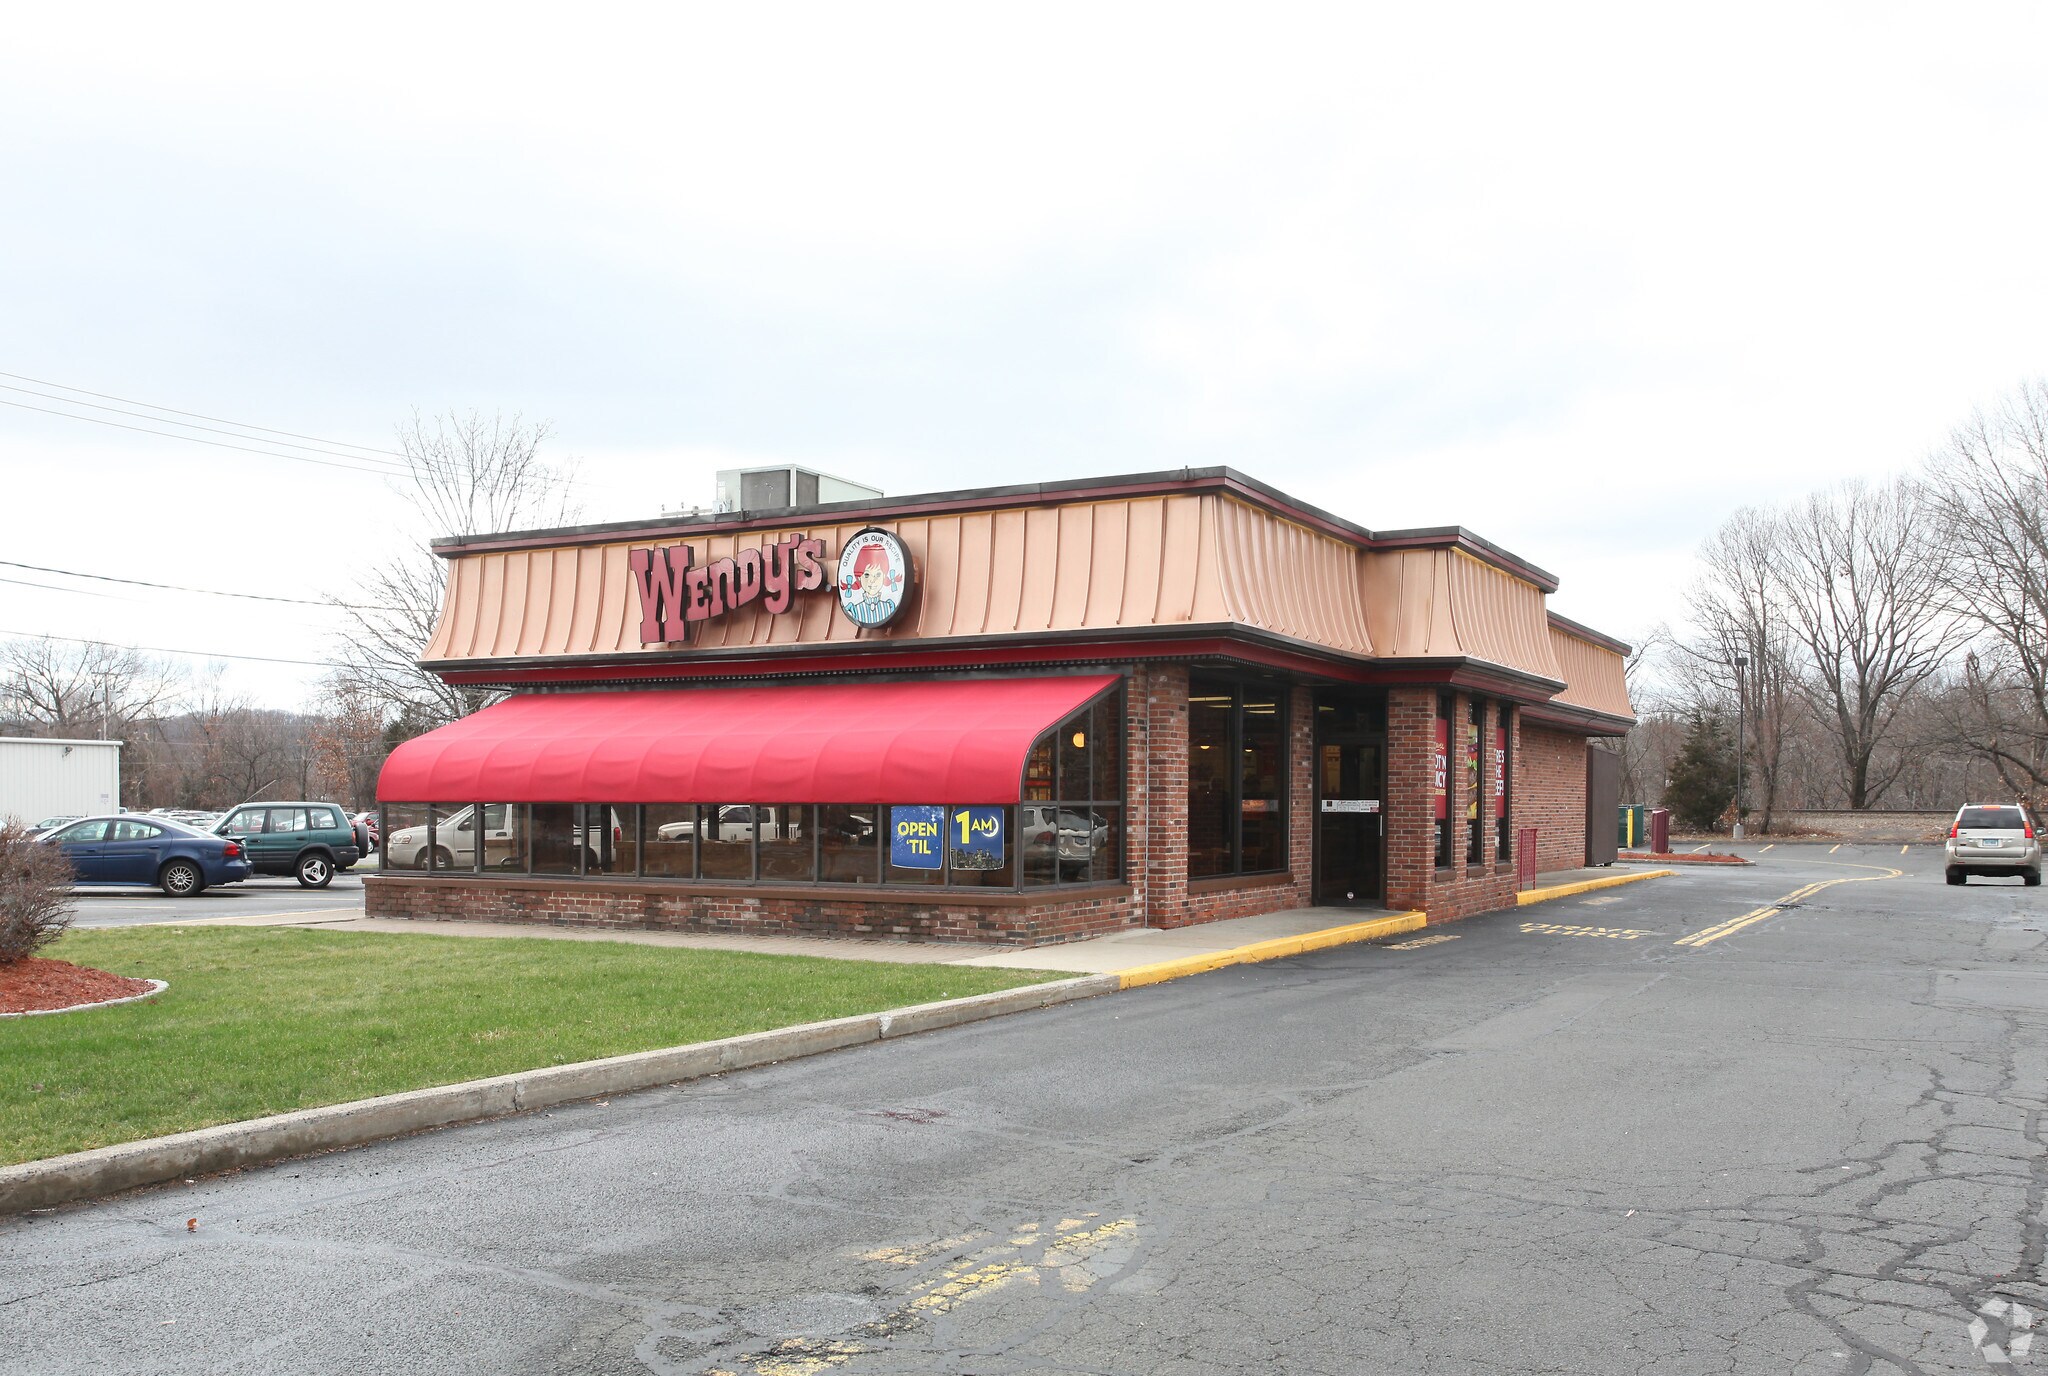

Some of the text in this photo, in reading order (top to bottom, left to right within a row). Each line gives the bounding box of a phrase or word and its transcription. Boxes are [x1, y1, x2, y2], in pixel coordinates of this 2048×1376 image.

[842, 540, 861, 567] QUALITY
[871, 535, 884, 543] OUR
[885, 540, 901, 563] RECIPE
[897, 821, 938, 837] OPEN
[955, 810, 993, 844] 1 AM
[906, 839, 932, 855] 'TIL
